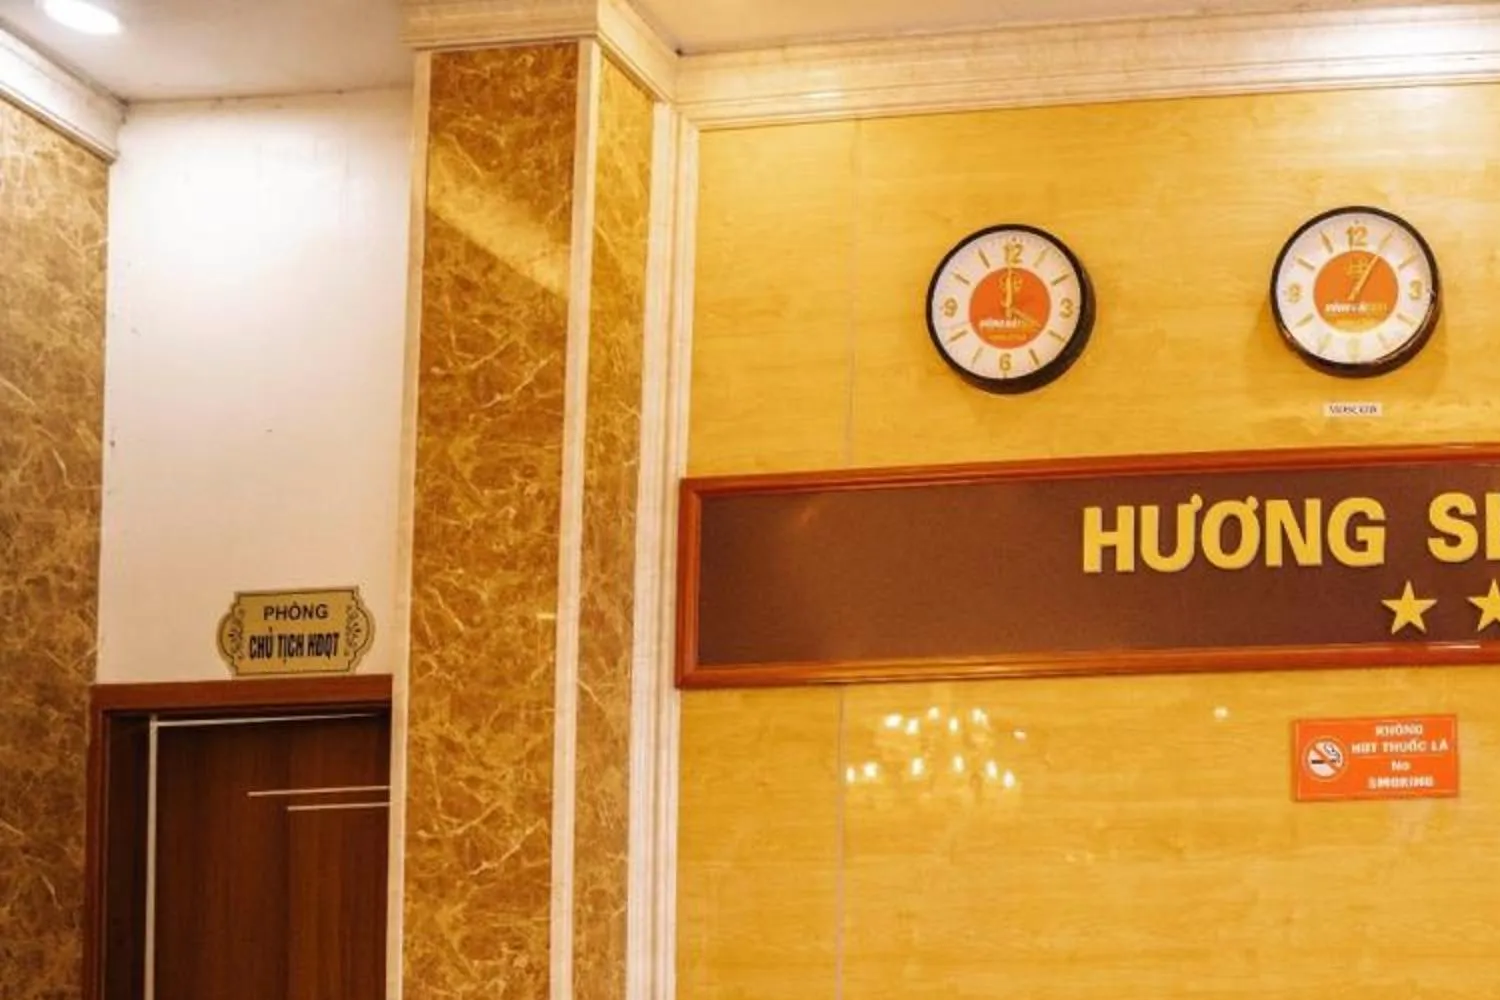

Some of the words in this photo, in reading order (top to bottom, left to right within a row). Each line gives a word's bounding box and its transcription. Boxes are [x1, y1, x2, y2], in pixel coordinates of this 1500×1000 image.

[1346, 226, 1368, 247] 12
[1004, 243, 1024, 264] 12
[943, 298, 958, 318] 9
[1059, 298, 1074, 318] 3
[999, 353, 1011, 371] 6
[1082, 493, 1387, 574] HƯƠNG
[263, 602, 329, 620] PHÒNG
[249, 627, 273, 660] CHỦ
[277, 632, 304, 664] TỊCH
